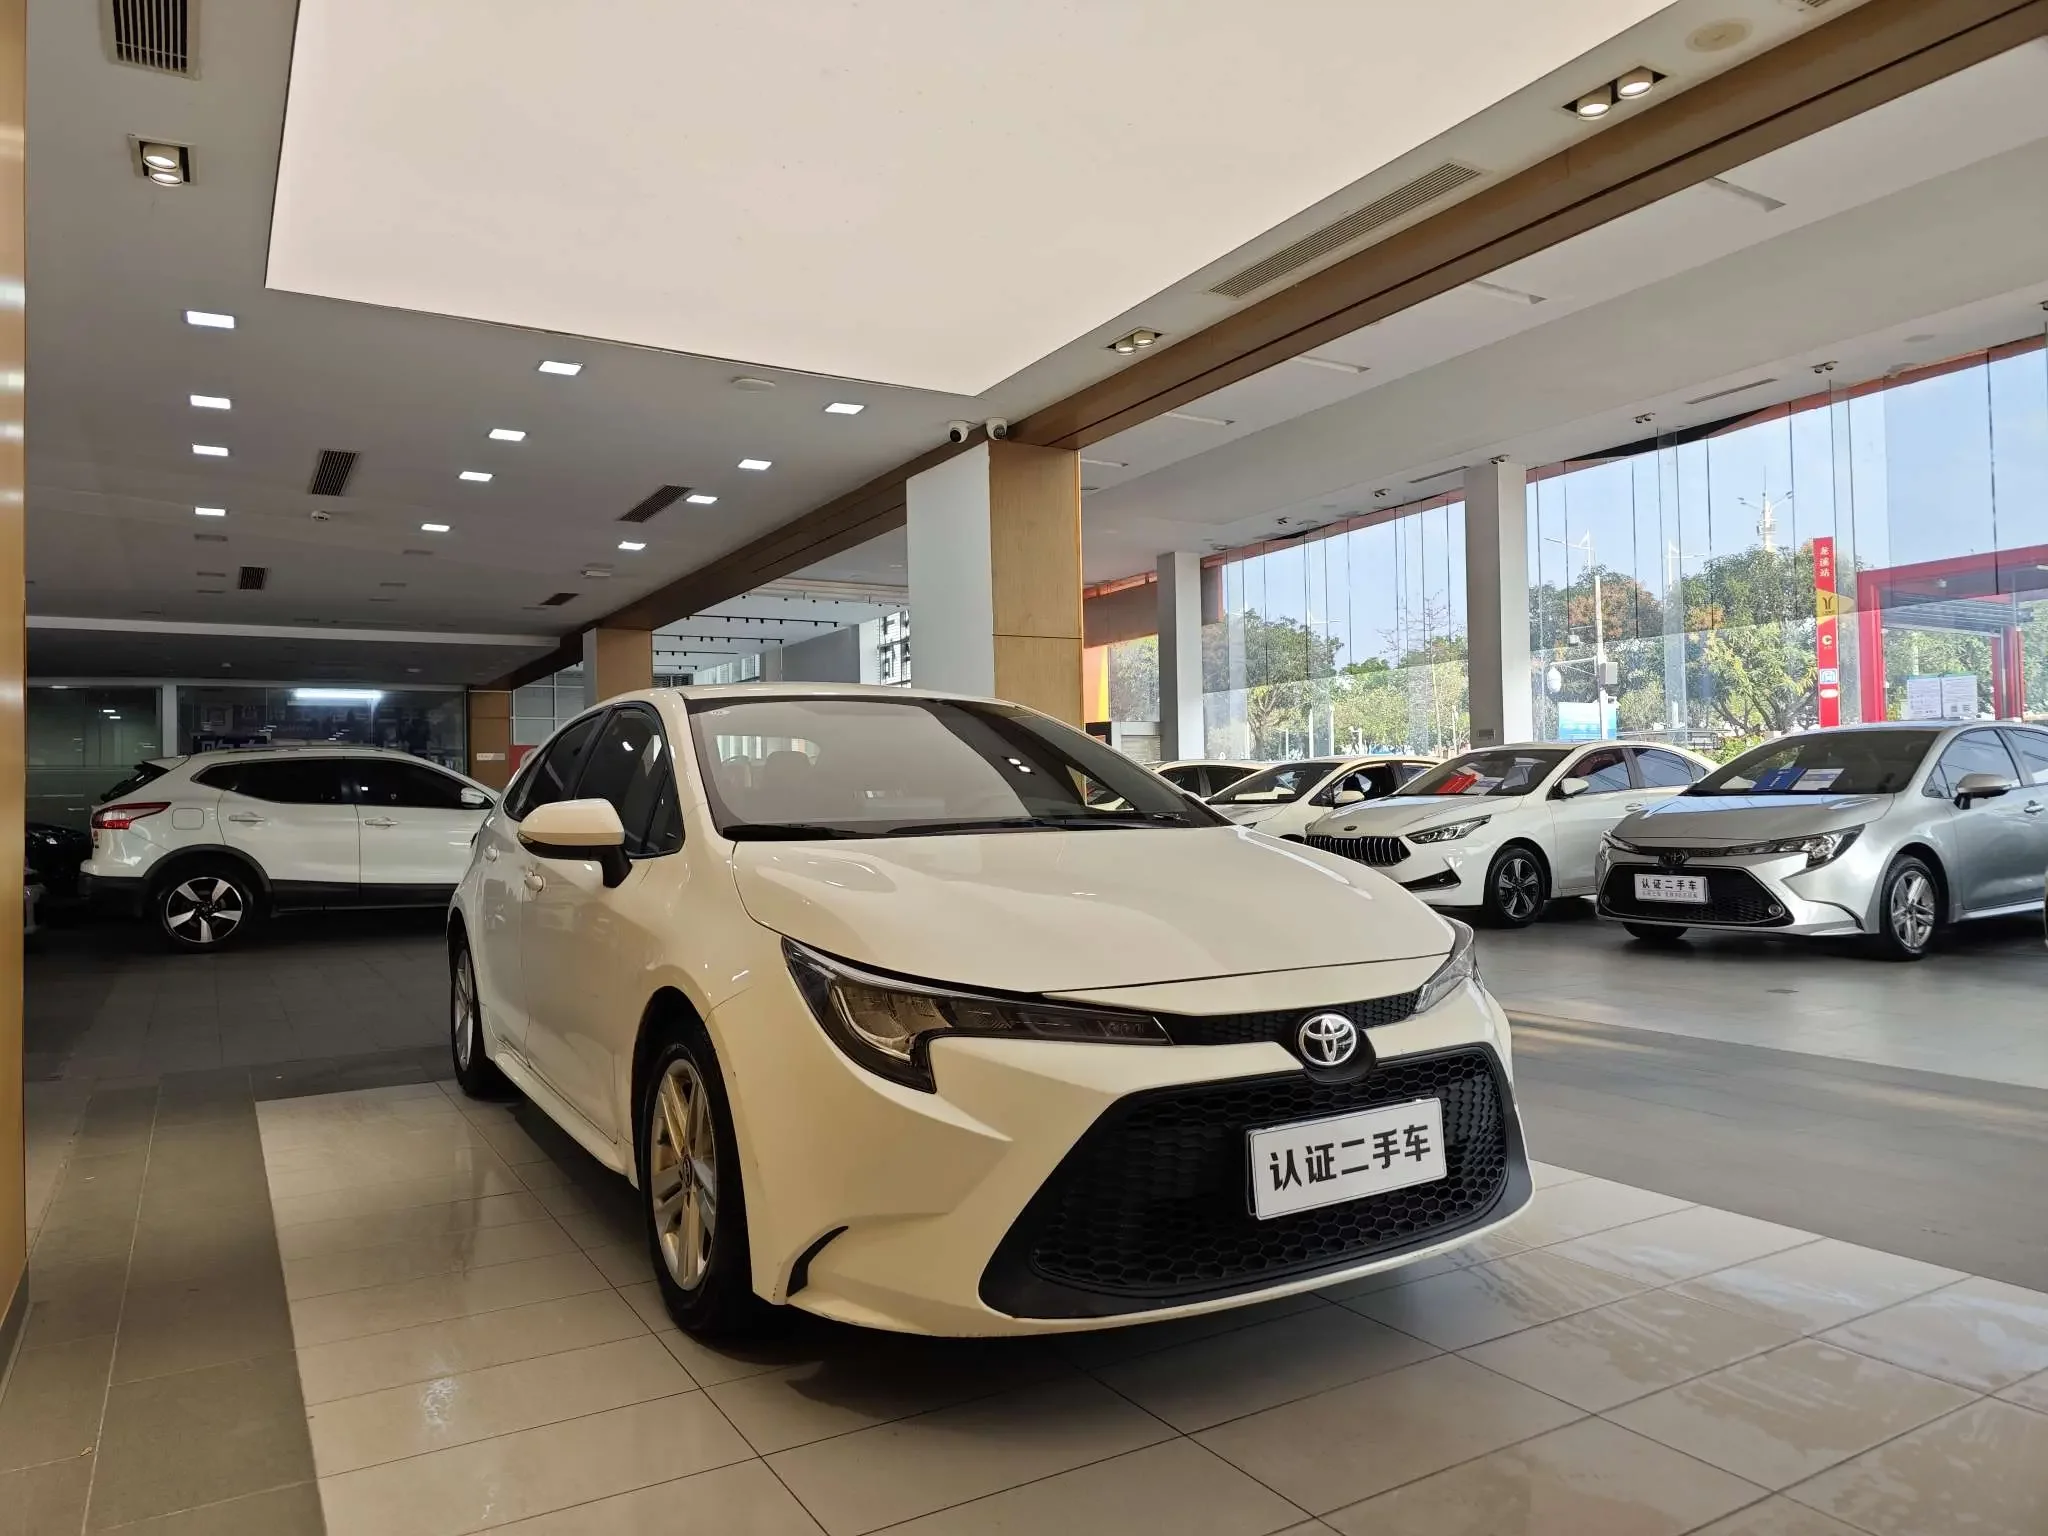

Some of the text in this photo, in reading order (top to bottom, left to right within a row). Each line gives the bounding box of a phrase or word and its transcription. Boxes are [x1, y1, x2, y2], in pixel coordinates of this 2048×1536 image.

[1641, 878, 1697, 891] 认证二手车
[1269, 1124, 1431, 1192] 认证二手车
